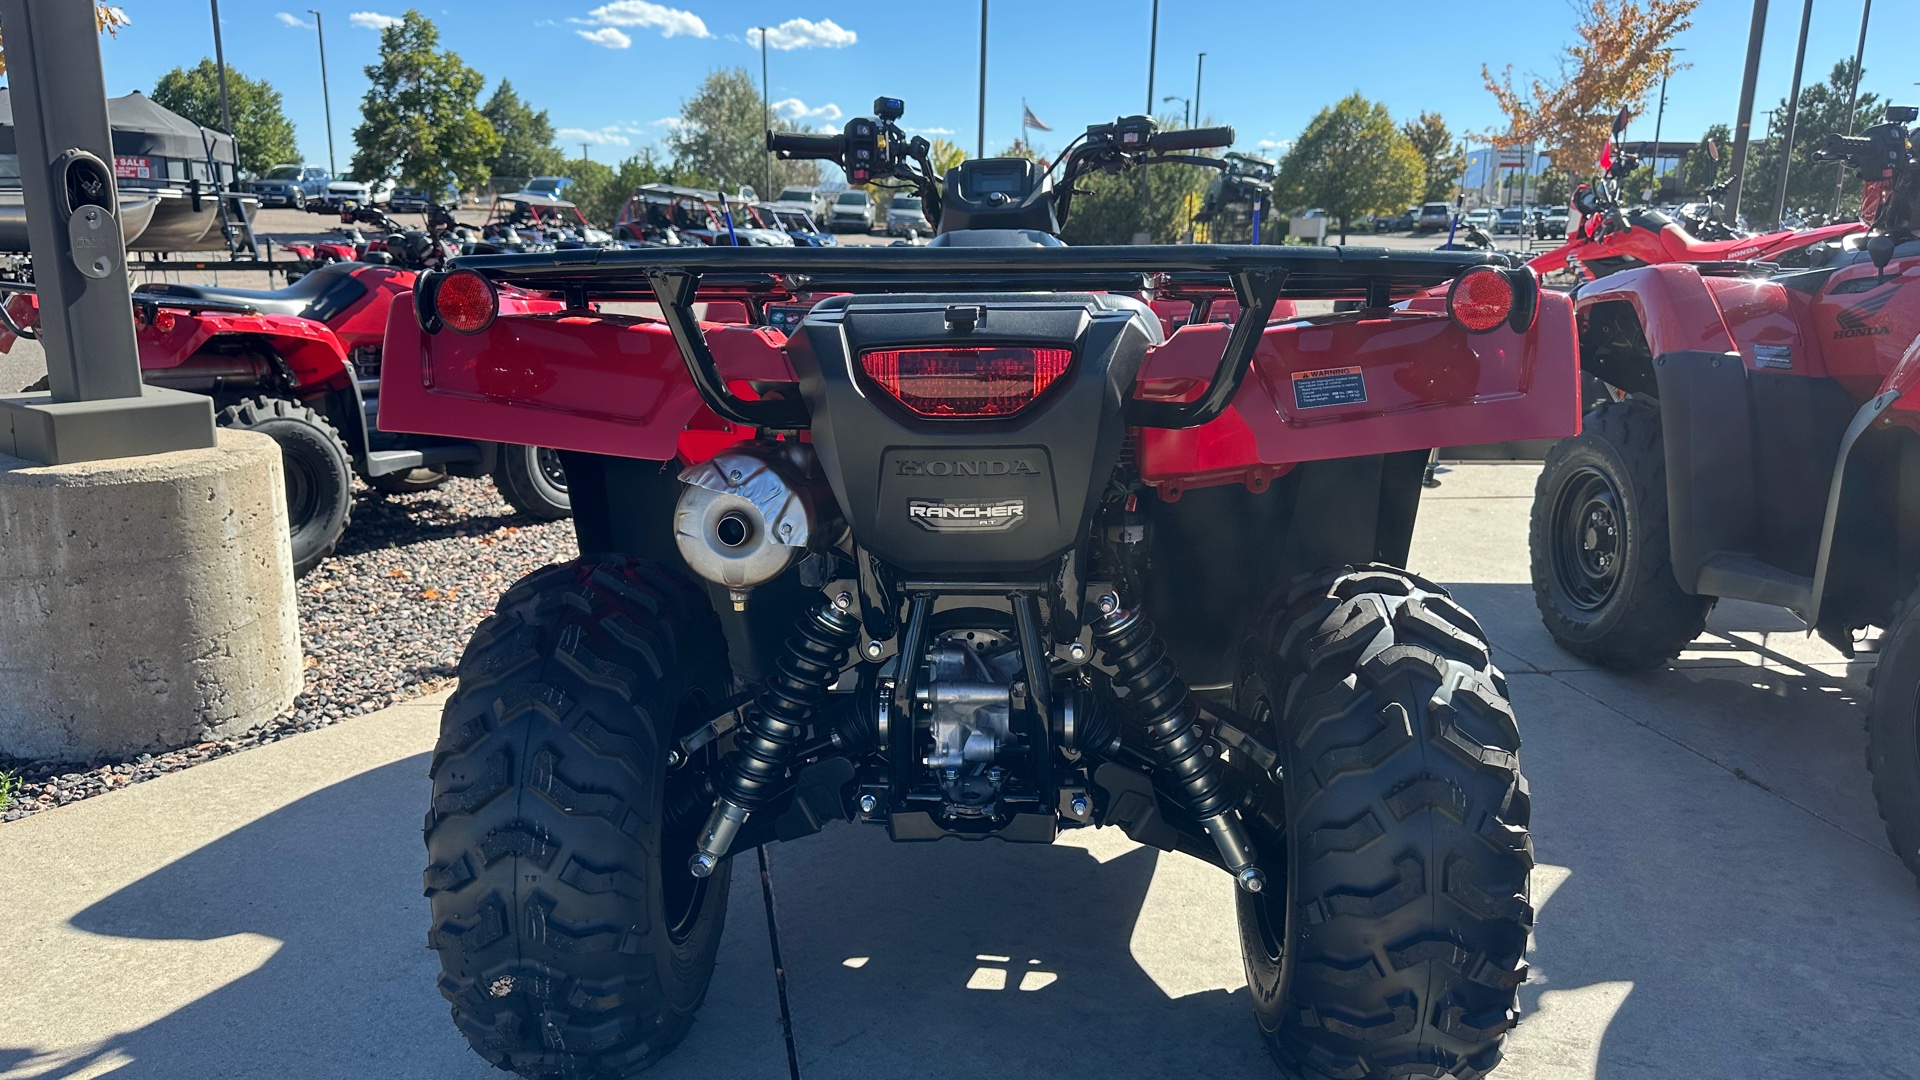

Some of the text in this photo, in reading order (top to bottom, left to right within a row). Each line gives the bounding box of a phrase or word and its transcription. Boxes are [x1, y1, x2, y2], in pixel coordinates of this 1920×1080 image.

[120, 158, 146, 167] SALE
[1727, 246, 1760, 260] HONDA
[1832, 326, 1891, 339] HONDA
[1311, 368, 1350, 378] WARNING
[896, 460, 1041, 476] HONDA
[910, 505, 1024, 518] RANCHER
